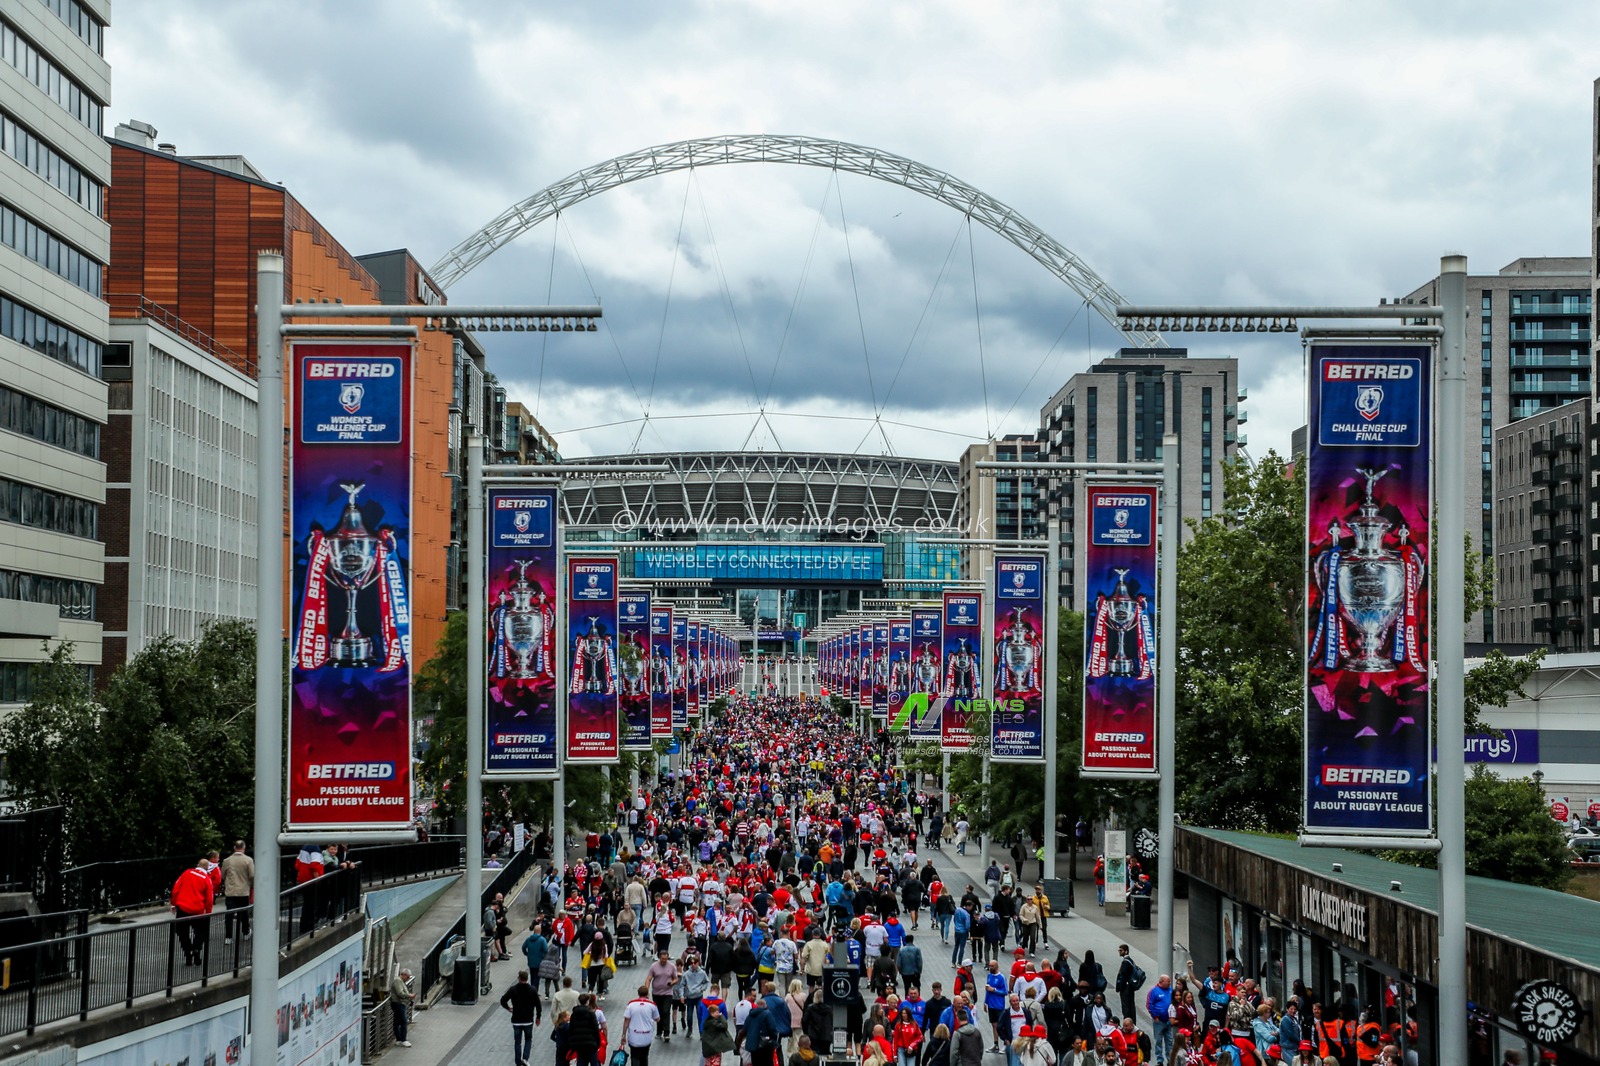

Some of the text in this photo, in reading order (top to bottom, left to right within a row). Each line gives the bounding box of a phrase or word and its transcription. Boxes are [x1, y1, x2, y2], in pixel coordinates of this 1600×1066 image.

[310, 364, 394, 377] BETFRED
[1328, 365, 1413, 379] BETFRED
[1332, 424, 1387, 432] CHALLENGE
[498, 500, 548, 508] BETFRED
[1097, 498, 1147, 506] BETFRED
[308, 537, 330, 599] BETFRED
[647, 554, 870, 570] WEMBLEY CONNECTED BY EE
[1328, 552, 1340, 605] BETFRED
[387, 560, 408, 623] BETFRED
[301, 609, 316, 668] BETFRED
[1326, 613, 1336, 668] BETFRED
[497, 735, 546, 744] BETFRED
[1095, 732, 1144, 742] BETFRED
[1463, 738, 1511, 758] urrys
[308, 764, 392, 778] BETFRED
[1325, 768, 1410, 784] BETFRED
[320, 786, 380, 795] PASSIONATE
[1338, 791, 1398, 800] PASSIONATE
[296, 797, 404, 806] ABOUT RUGBY LEAGUE
[1313, 802, 1423, 812] ABOUT RUGBY LEAGUE
[1302, 884, 1366, 942] BLACK SHEEP COFFEE
[852, 950, 859, 960] 9
[1521, 986, 1574, 1022] BLACK SHEEP
[1537, 1018, 1576, 1042] COFFEE
